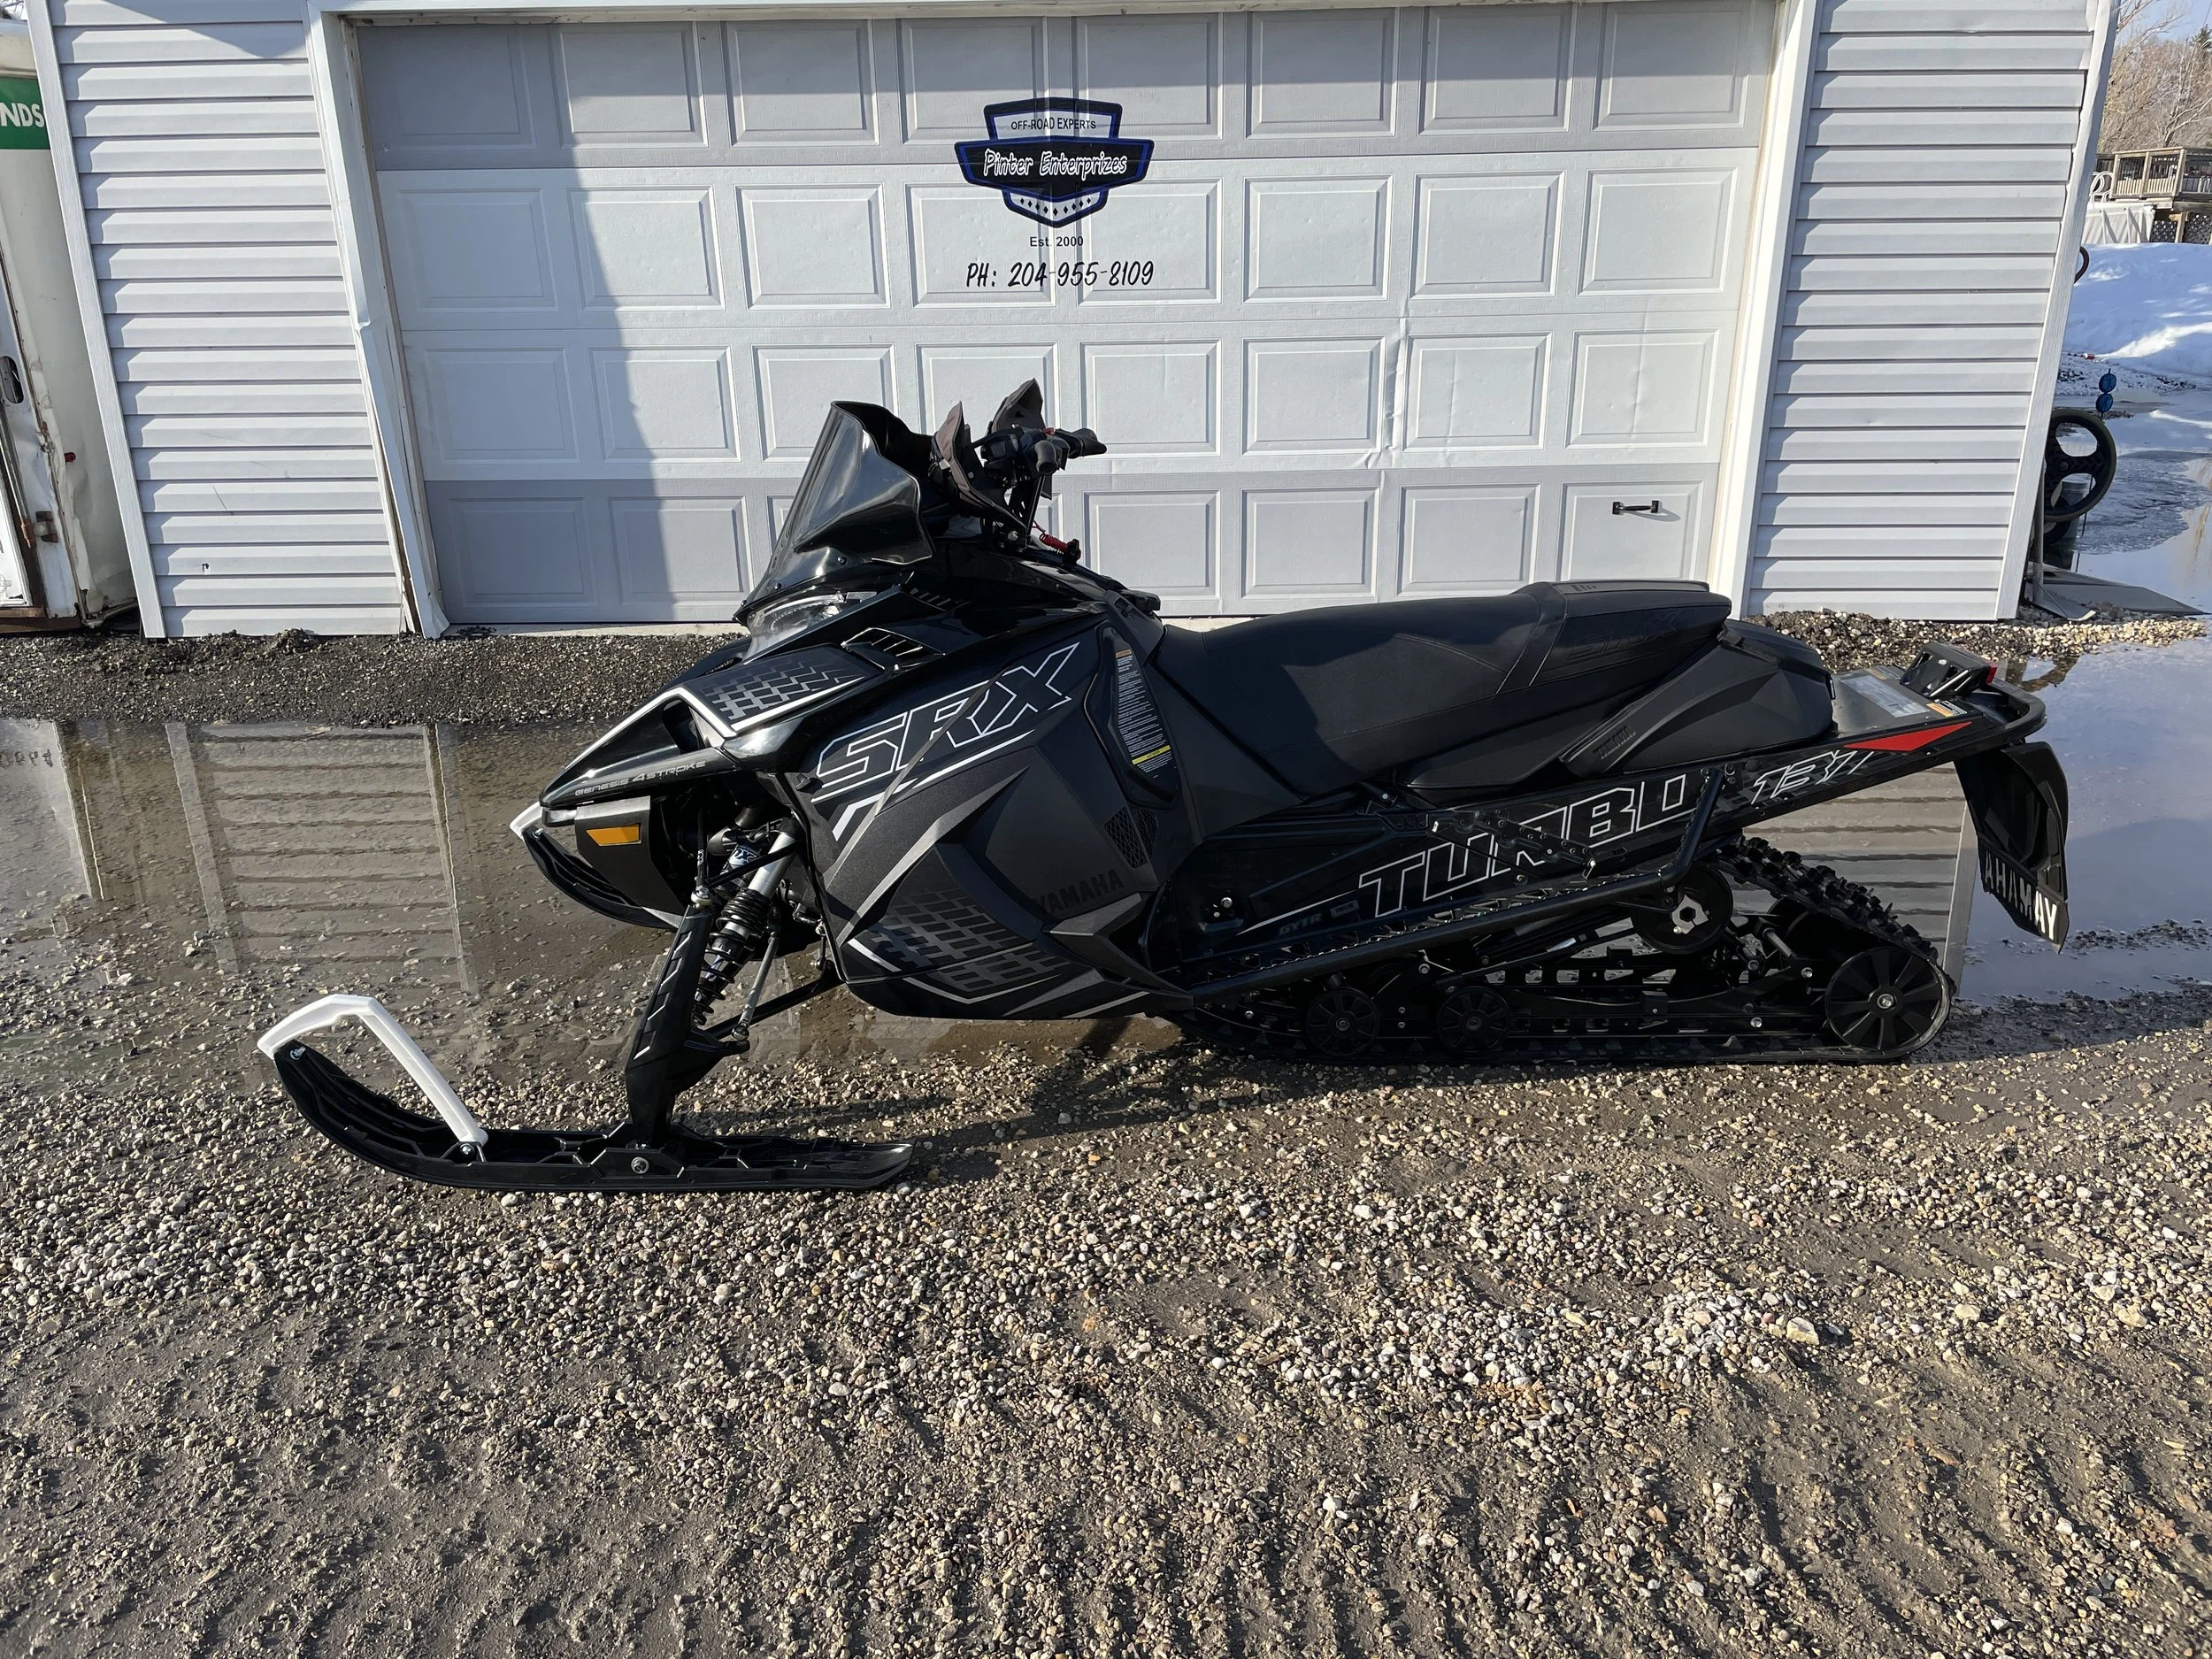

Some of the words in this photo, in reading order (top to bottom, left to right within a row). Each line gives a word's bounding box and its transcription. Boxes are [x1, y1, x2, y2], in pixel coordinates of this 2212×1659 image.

[1010, 117, 1055, 130] OFF-ROAD
[1057, 117, 1096, 130] EXPERTS
[983, 149, 1033, 176] Pinter
[1039, 150, 1127, 180] Enterprizes
[1030, 236, 1051, 247] Est.
[1056, 235, 1084, 247] 2000
[966, 262, 997, 287] PH:
[1007, 260, 1155, 287] 204-955-8109
[811, 642, 1079, 802] SRX
[574, 778, 629, 796] GENESIS
[1033, 869, 1125, 914] YAMAHA
